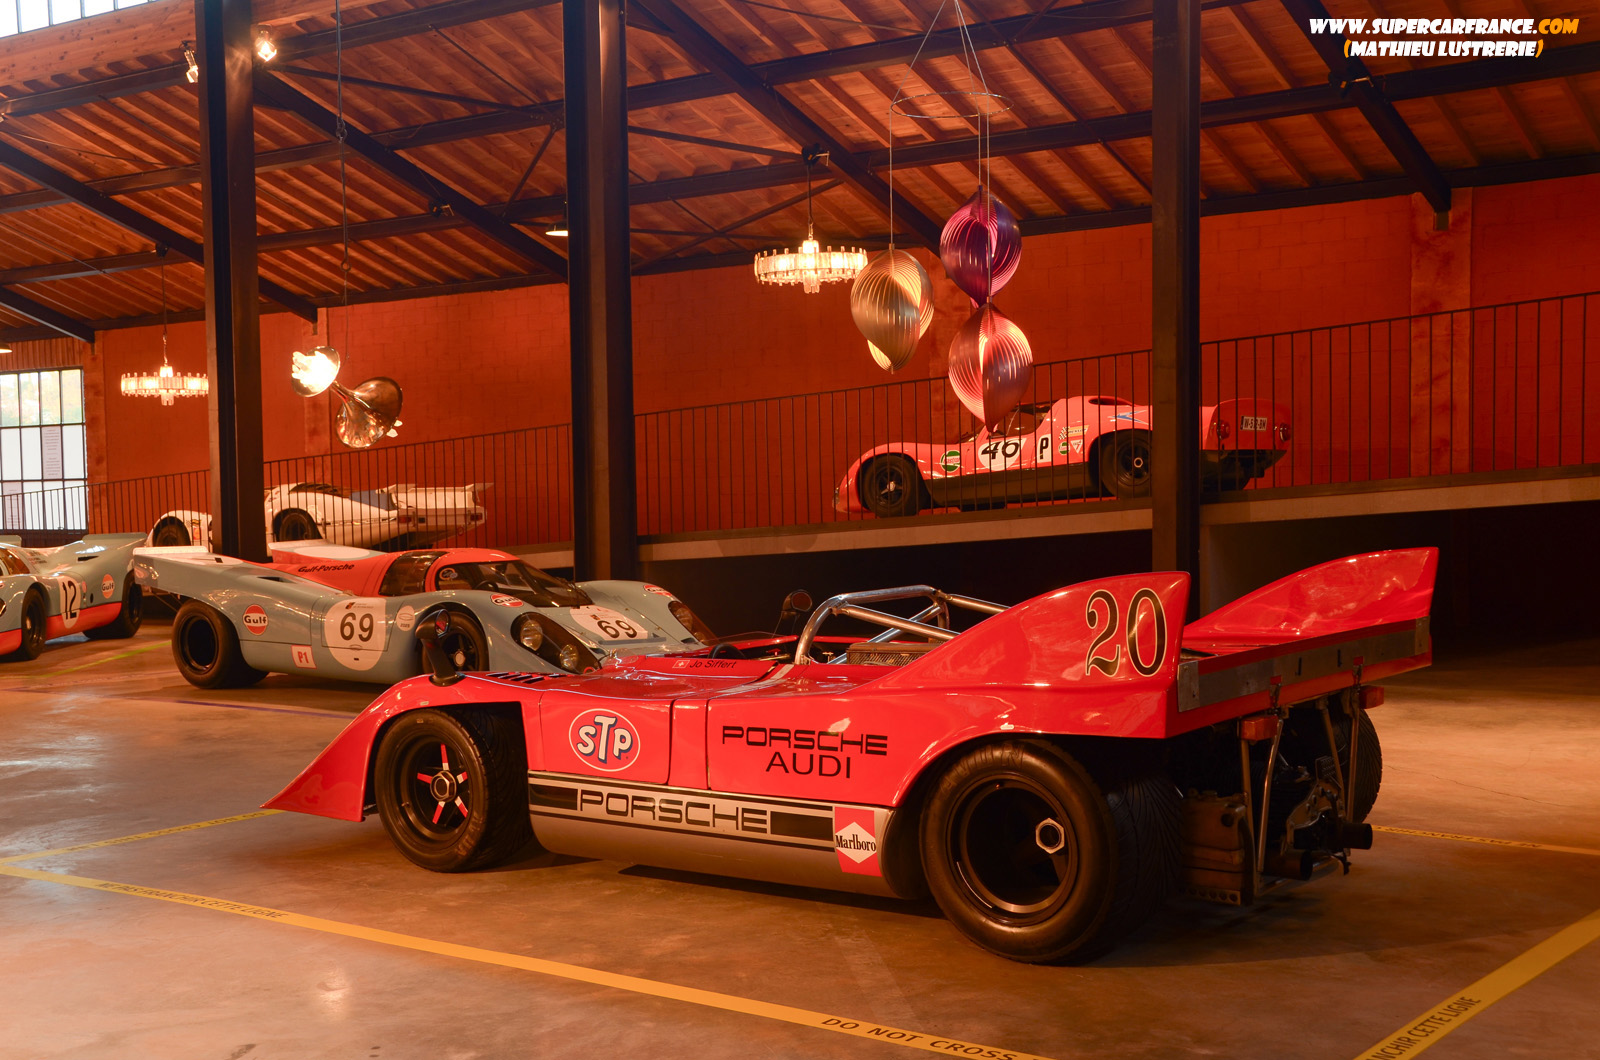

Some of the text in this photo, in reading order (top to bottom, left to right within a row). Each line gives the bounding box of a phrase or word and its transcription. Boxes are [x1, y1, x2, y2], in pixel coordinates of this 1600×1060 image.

[1039, 437, 1049, 460] P
[298, 564, 355, 573] Gulf-Porsche
[62, 580, 77, 620] 12
[101, 582, 115, 591] Gulf
[243, 614, 268, 625] Gulf
[339, 612, 374, 642] 69
[597, 619, 638, 639] 69
[1085, 587, 1168, 678] 20
[297, 650, 310, 664] P1
[689, 659, 737, 669] Jo Siffert
[577, 714, 633, 765] STP
[722, 725, 888, 756] PORSCHE
[765, 751, 851, 779] AUDI
[580, 789, 768, 834] PORSCHE
[835, 832, 877, 853] Marlboro
[1406, 1015, 1452, 1038] CETTE
[1437, 996, 1482, 1018] LIGNE
[821, 1018, 1018, 1060] DO NOT CROSS
